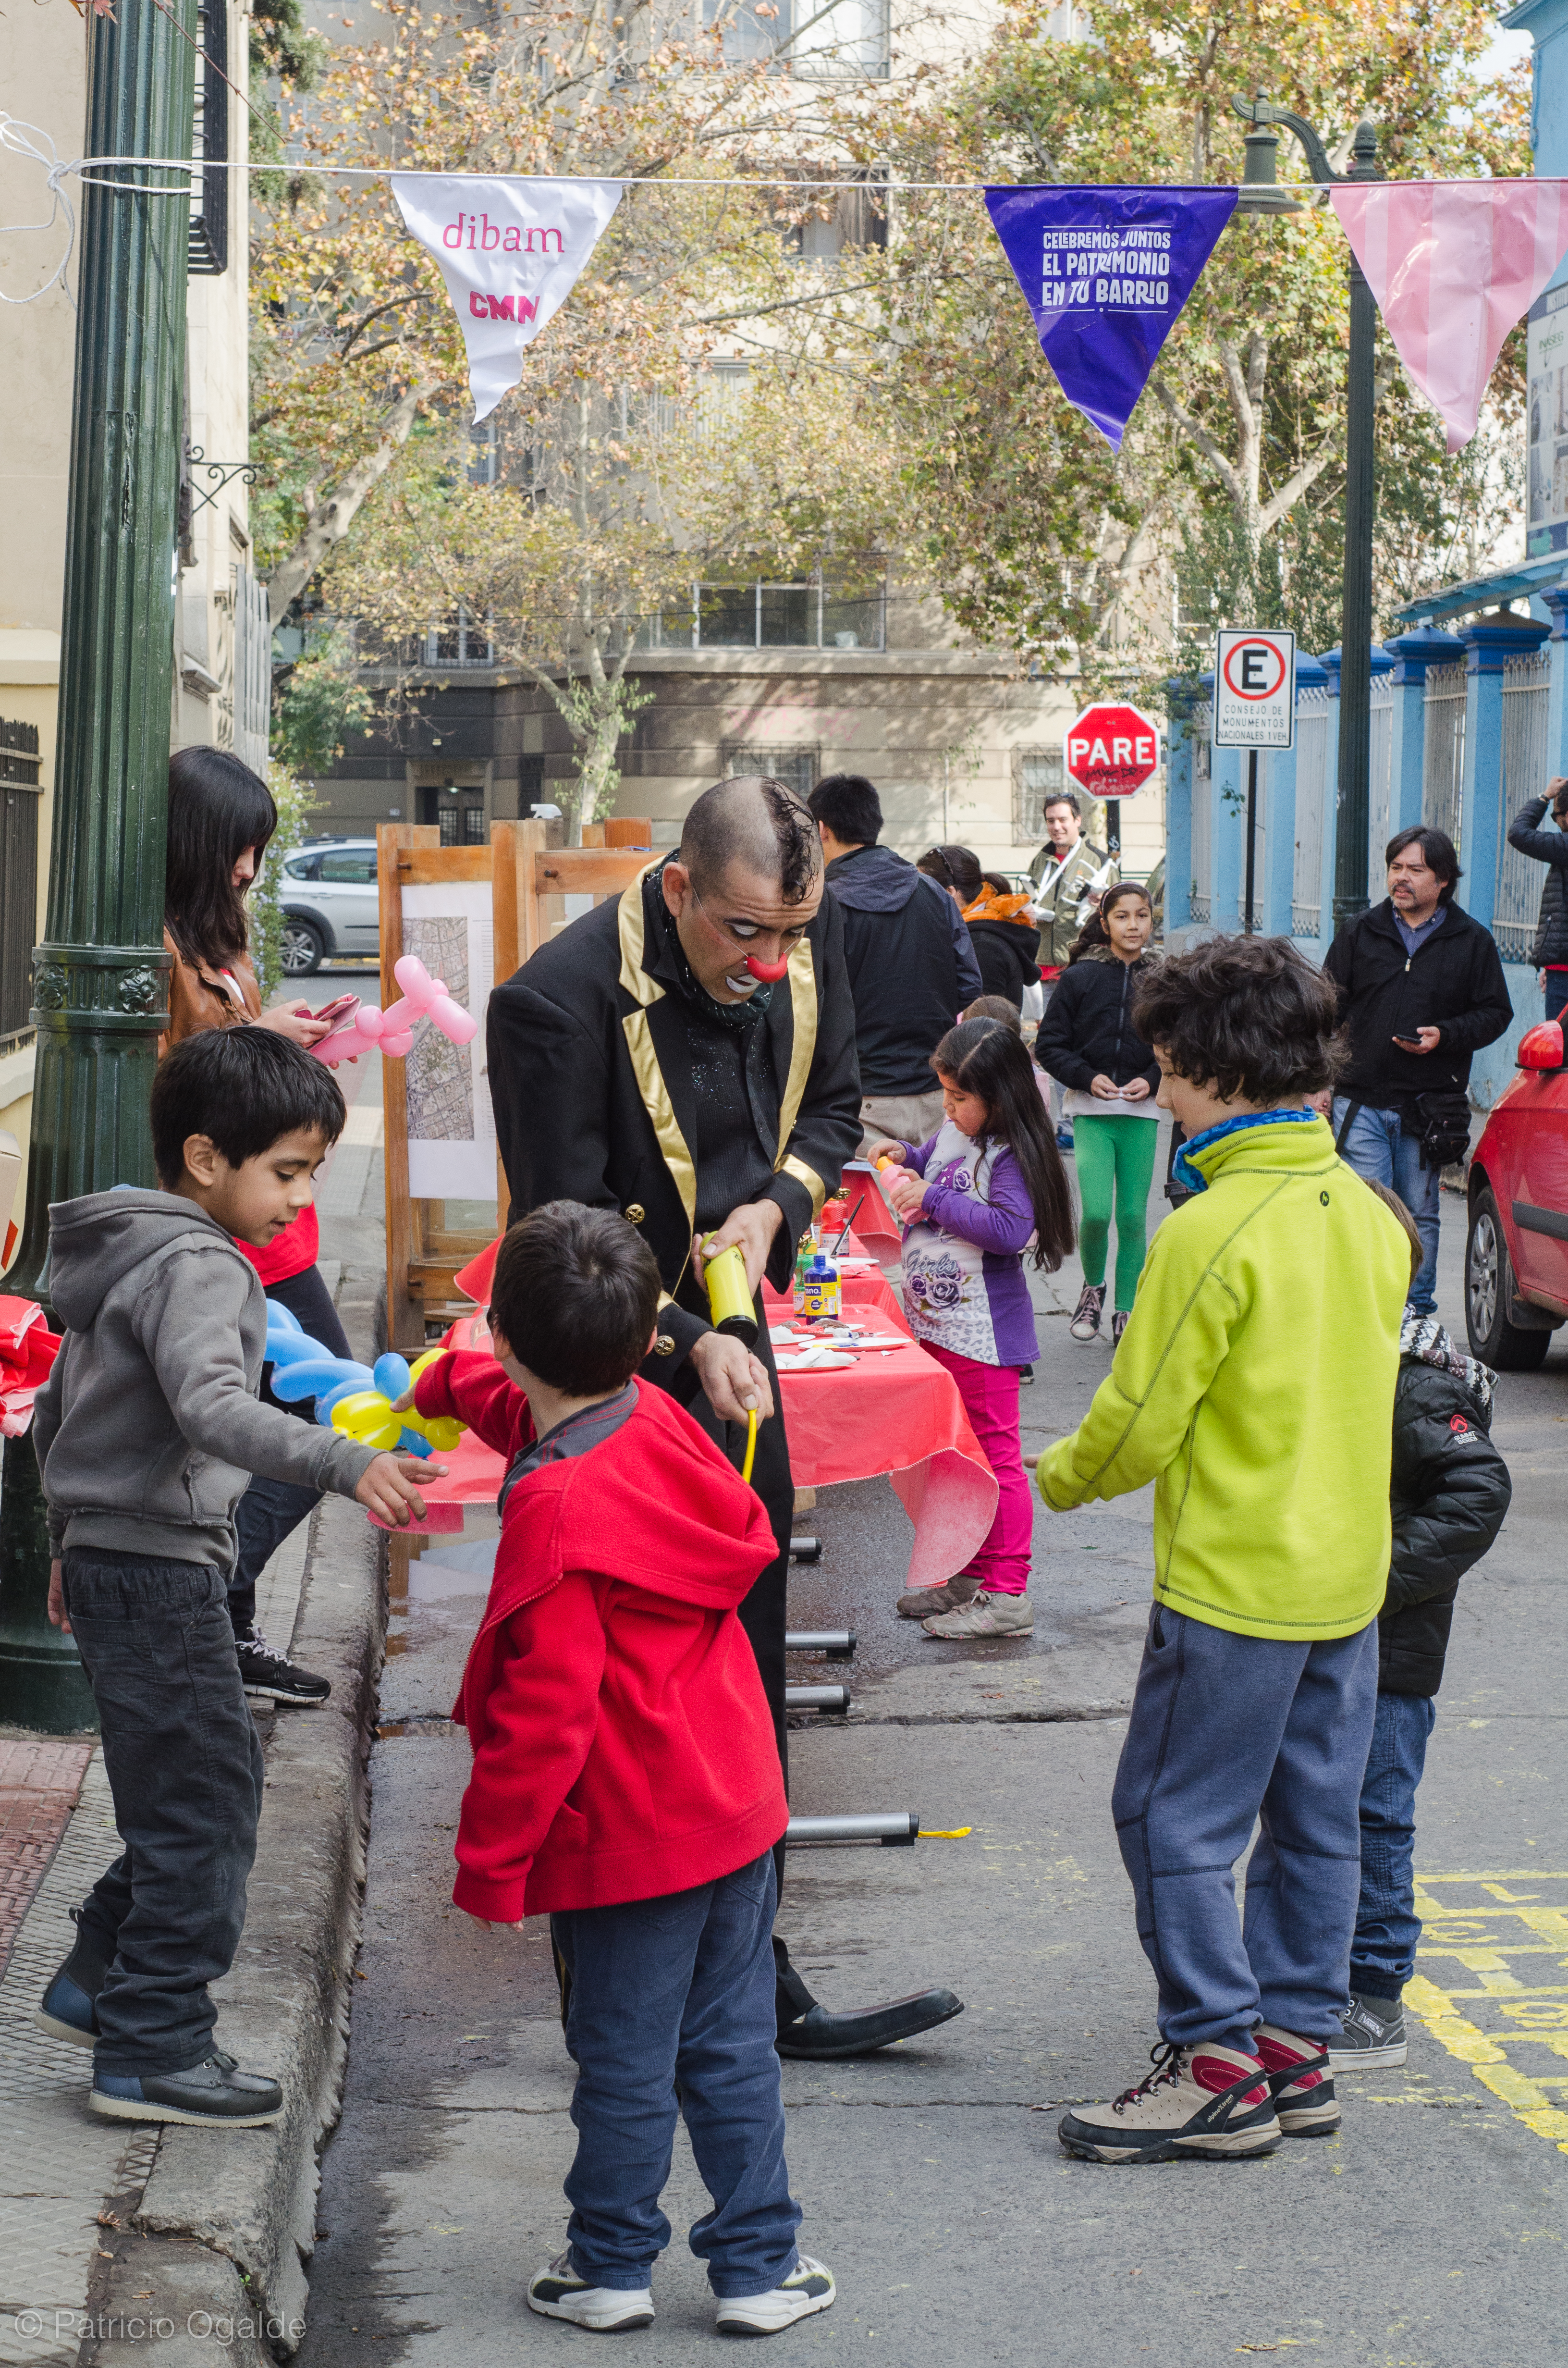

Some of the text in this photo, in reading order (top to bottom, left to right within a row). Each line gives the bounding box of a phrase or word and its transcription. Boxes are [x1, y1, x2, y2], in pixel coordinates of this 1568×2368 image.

[443, 212, 565, 253] dibam
[1043, 231, 1171, 249] CELEBREMOS JUNTOS
[1043, 250, 1170, 276] EL PATRIMONIO
[1042, 279, 1169, 307] EN TU BARRIO
[469, 291, 541, 324] CMN
[1242, 649, 1268, 690] E
[1225, 704, 1283, 715] CONSEJO DE
[1223, 718, 1284, 728] MONUMENTOS
[1218, 730, 1264, 740] NACIONALES
[1070, 737, 1153, 767] PARE
[907, 1248, 959, 1278] Girls
[1454, 1431, 1475, 1441] SUMMIT
[1458, 1436, 1478, 1444] SERIES
[1363, 2015, 1377, 2030] VANS
